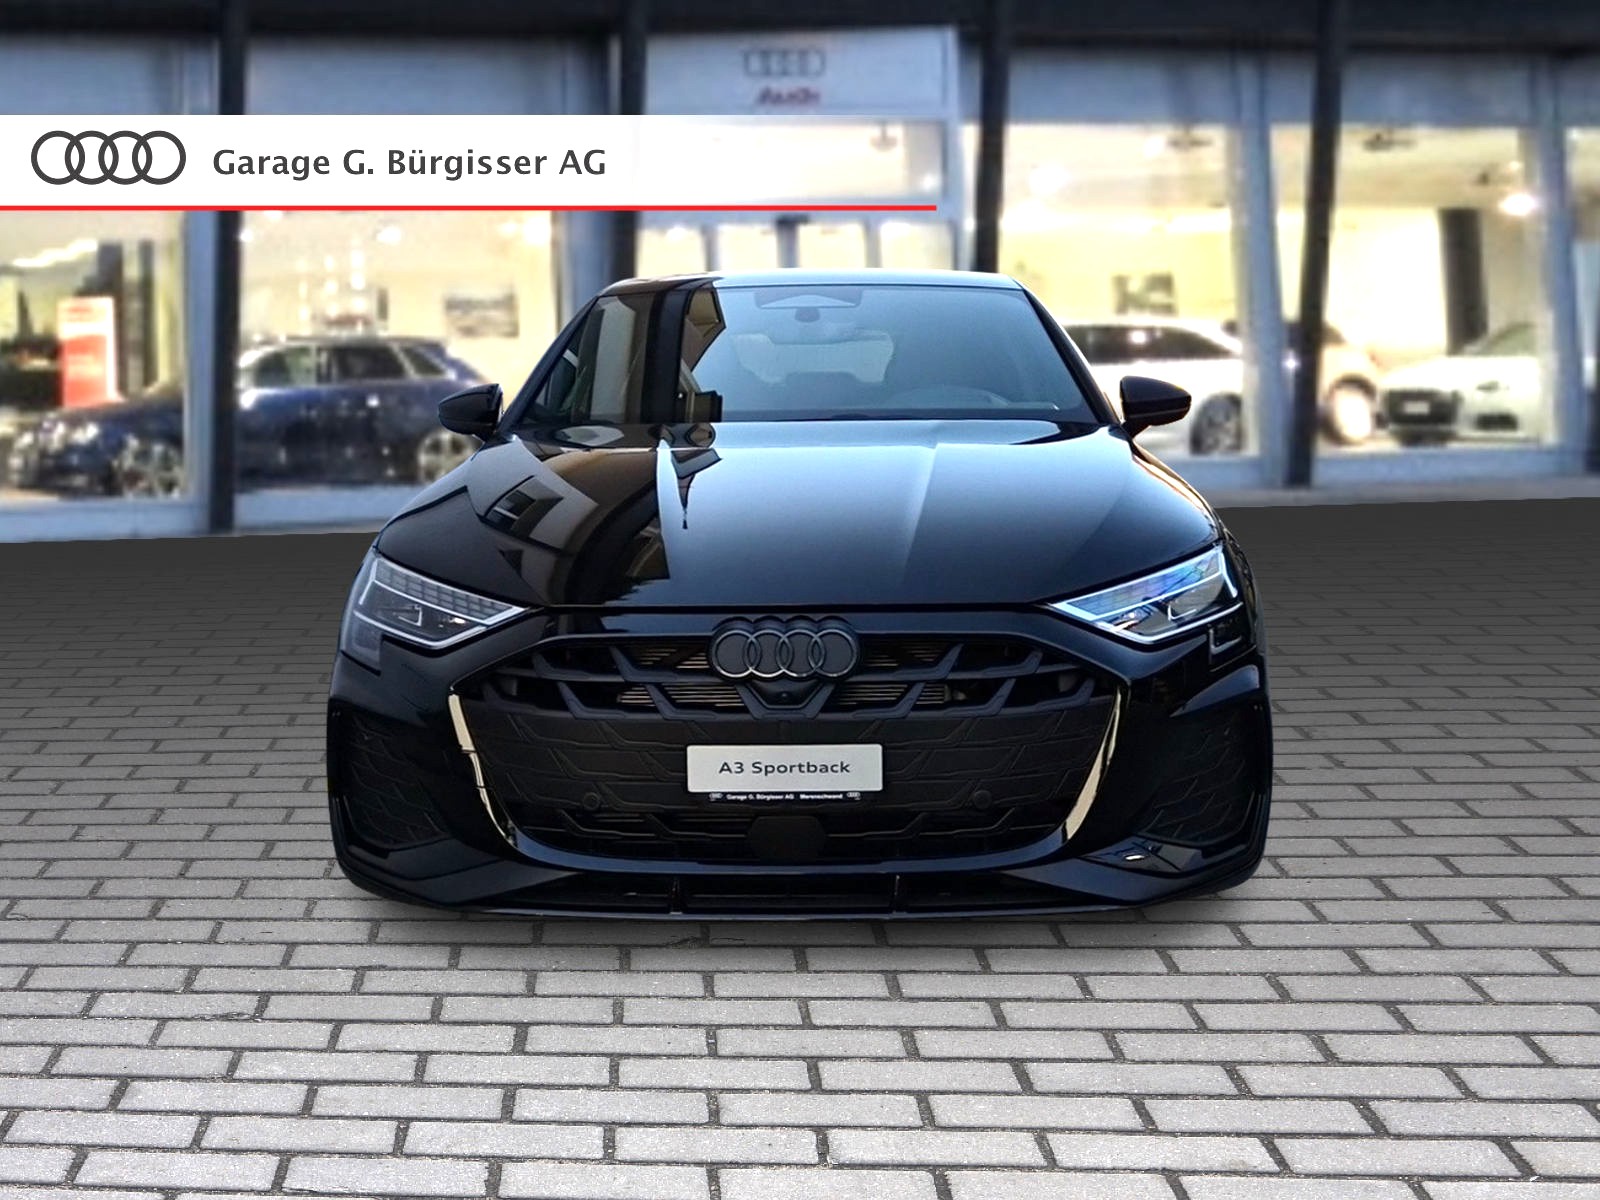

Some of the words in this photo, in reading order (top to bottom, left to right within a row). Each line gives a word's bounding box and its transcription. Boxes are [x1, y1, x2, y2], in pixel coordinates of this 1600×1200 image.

[718, 761, 745, 774] A3
[751, 760, 851, 777] Sportback
[726, 793, 747, 801] Garage
